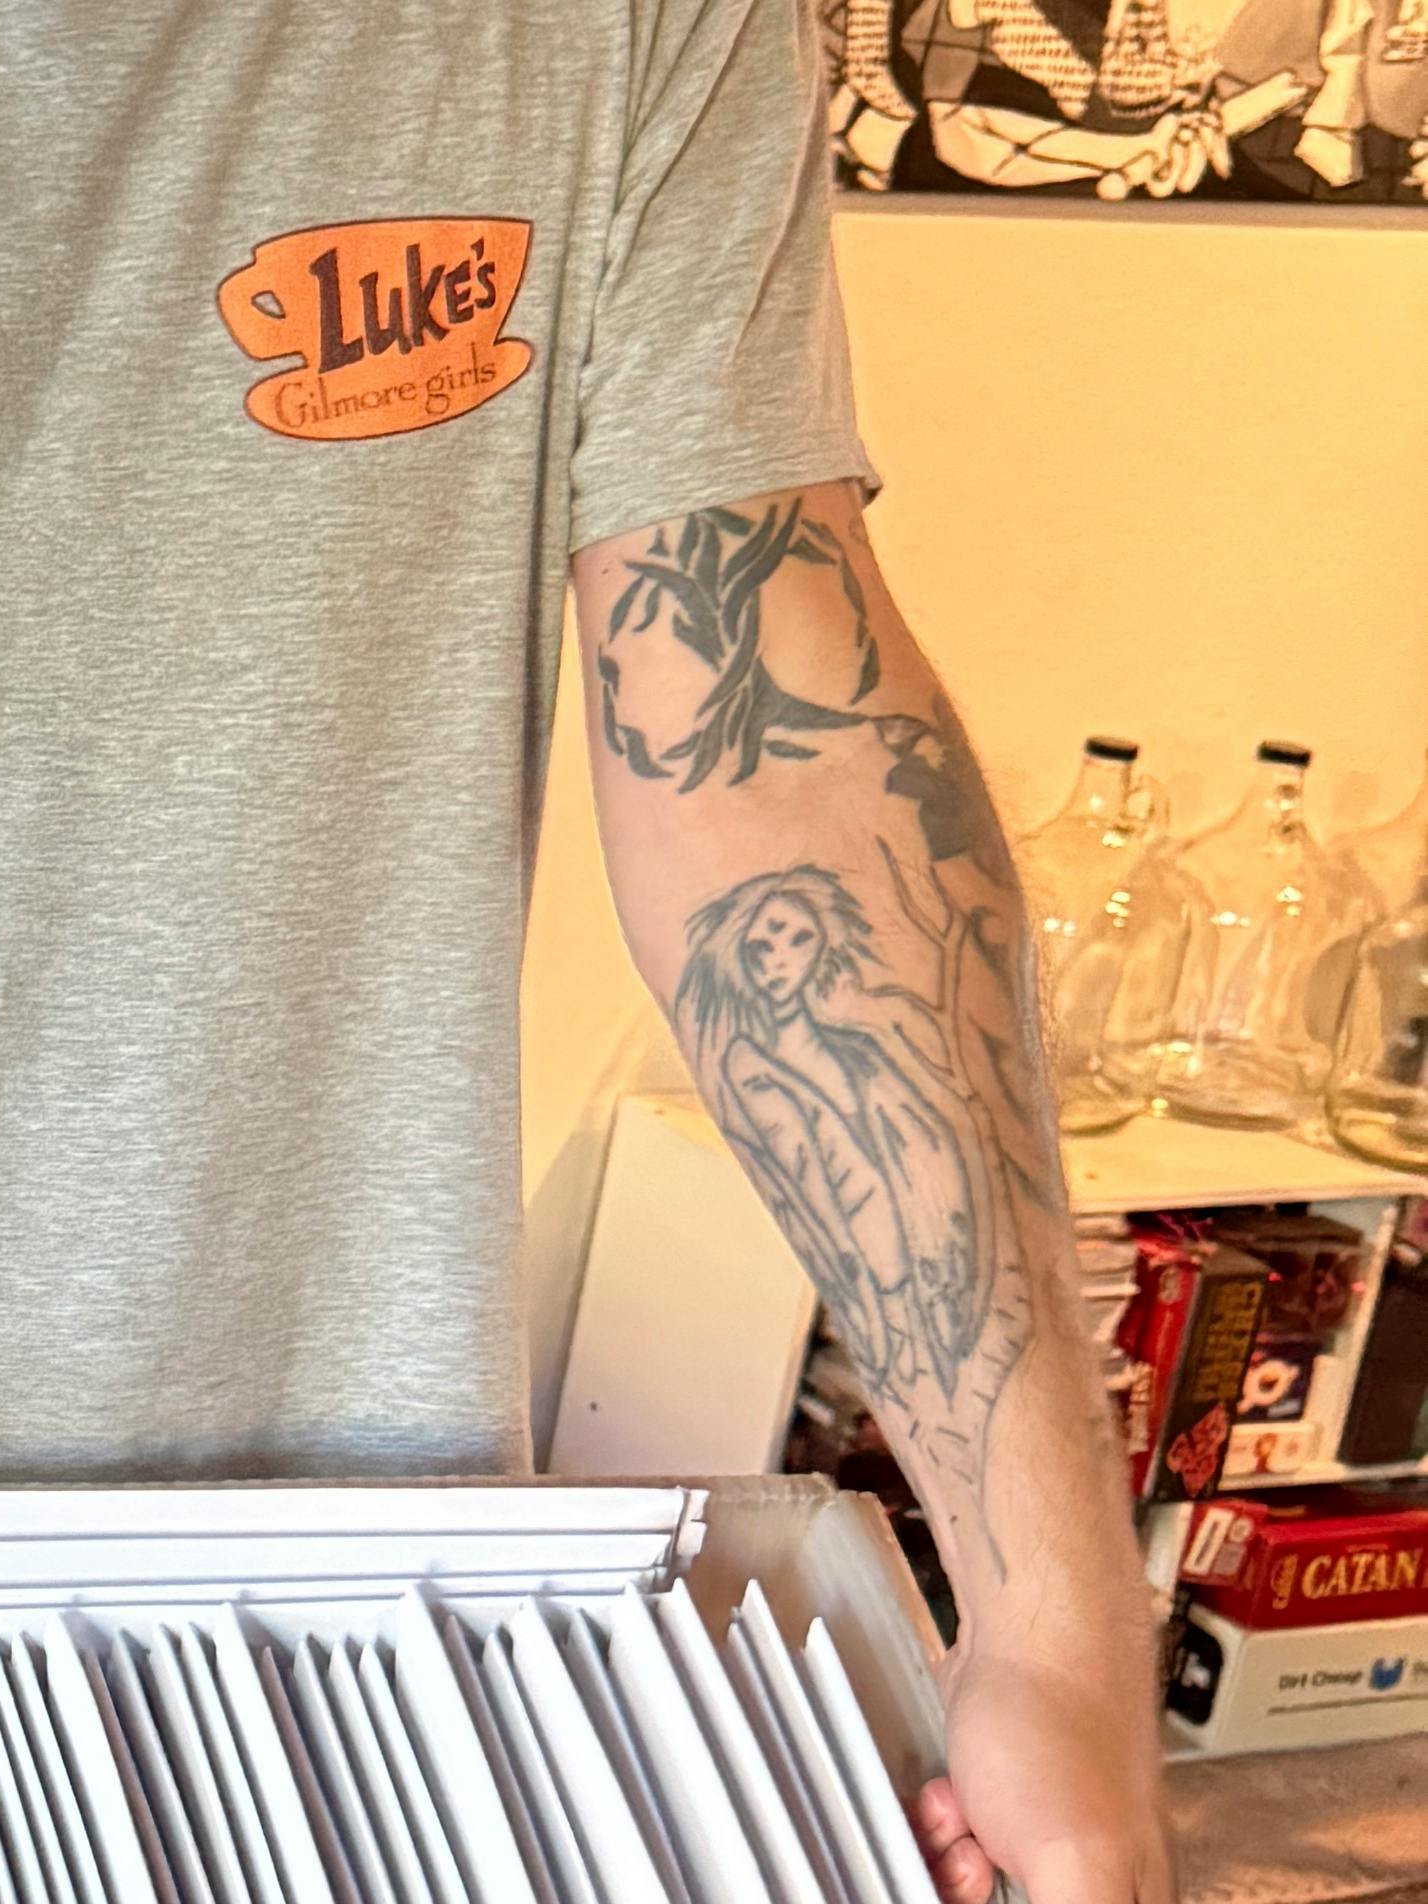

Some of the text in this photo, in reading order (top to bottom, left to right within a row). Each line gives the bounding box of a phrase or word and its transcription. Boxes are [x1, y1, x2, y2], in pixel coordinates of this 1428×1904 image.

[275, 342, 497, 428] Gilmore girls
[1301, 1548, 1424, 1599] CATAN
